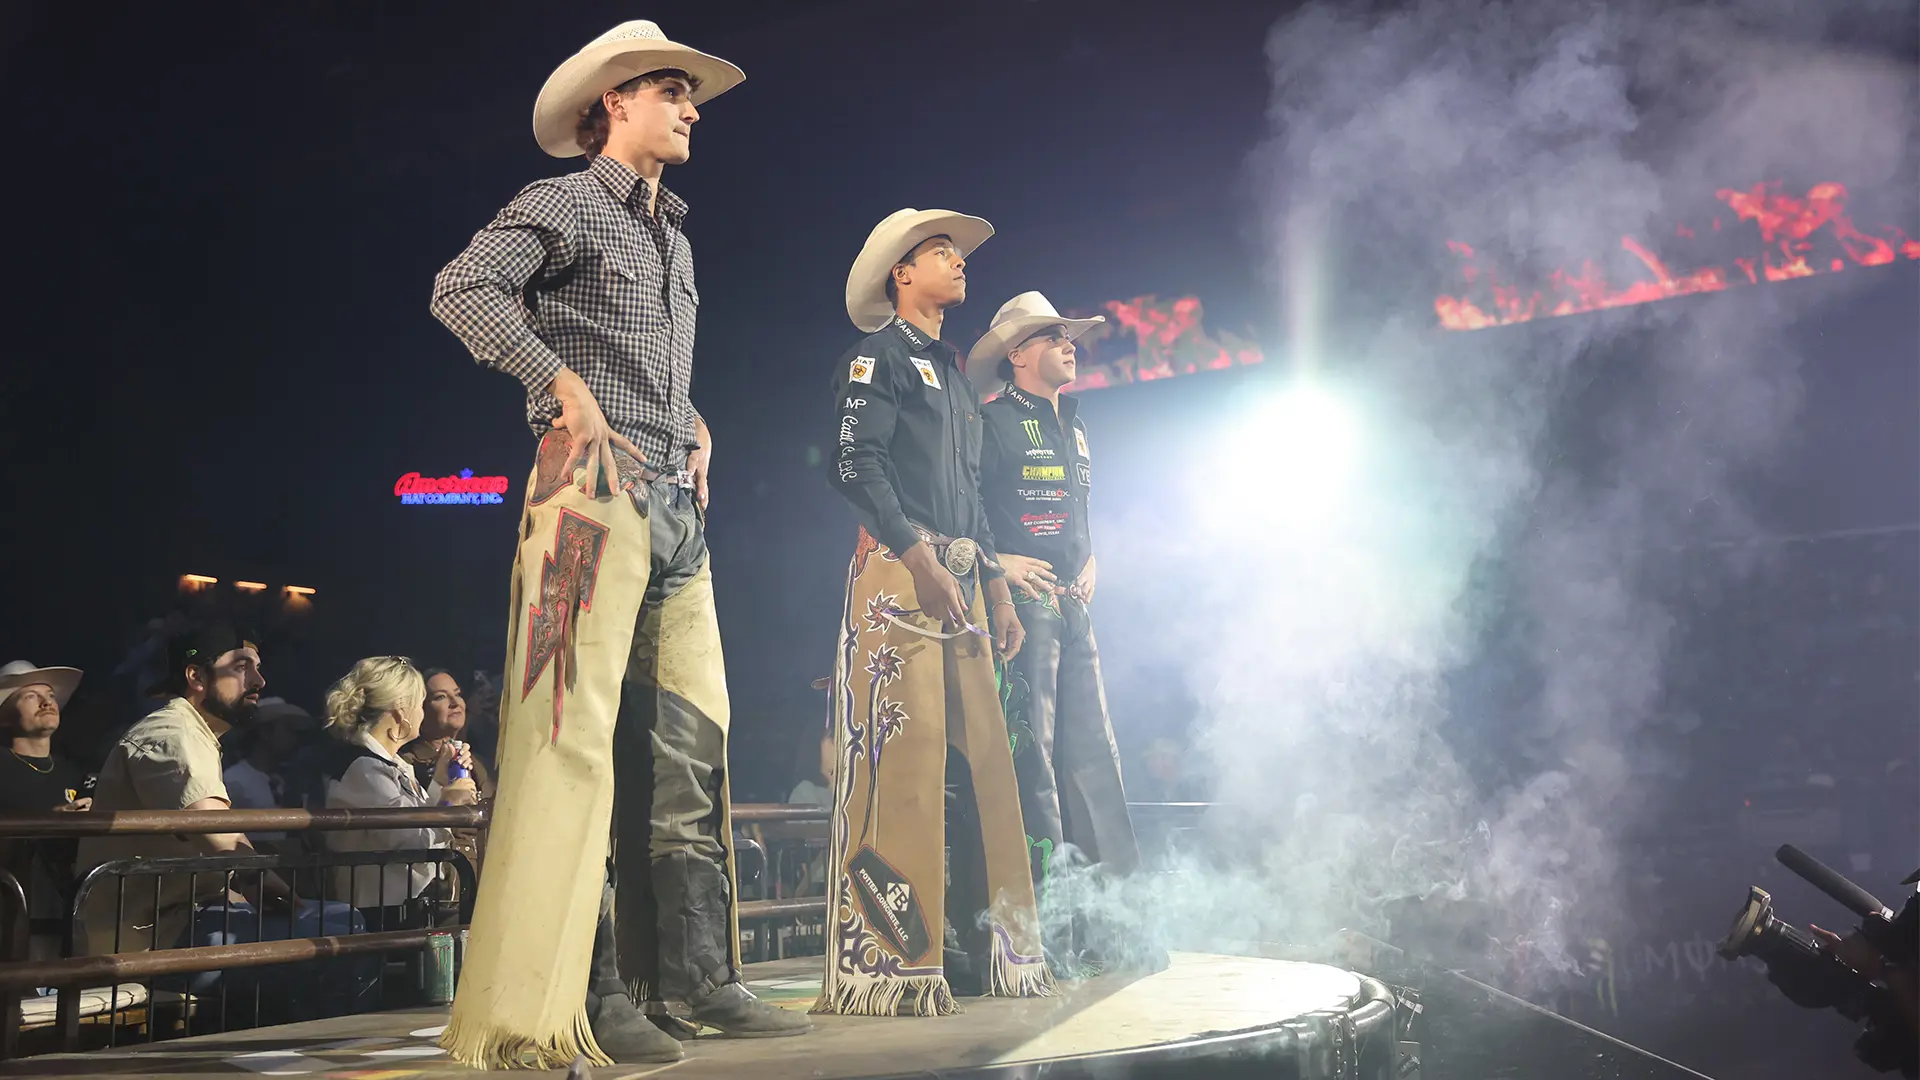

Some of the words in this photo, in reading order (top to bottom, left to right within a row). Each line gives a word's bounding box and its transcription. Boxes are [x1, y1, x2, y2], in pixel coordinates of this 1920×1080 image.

[900, 324, 922, 346] ARIAT
[1010, 391, 1035, 410] ARIAT
[1017, 489, 1069, 498] TURTLEBOX
[859, 868, 878, 897] POTTER
[876, 892, 899, 929] CONCRETE,
[898, 927, 909, 942] LLC
